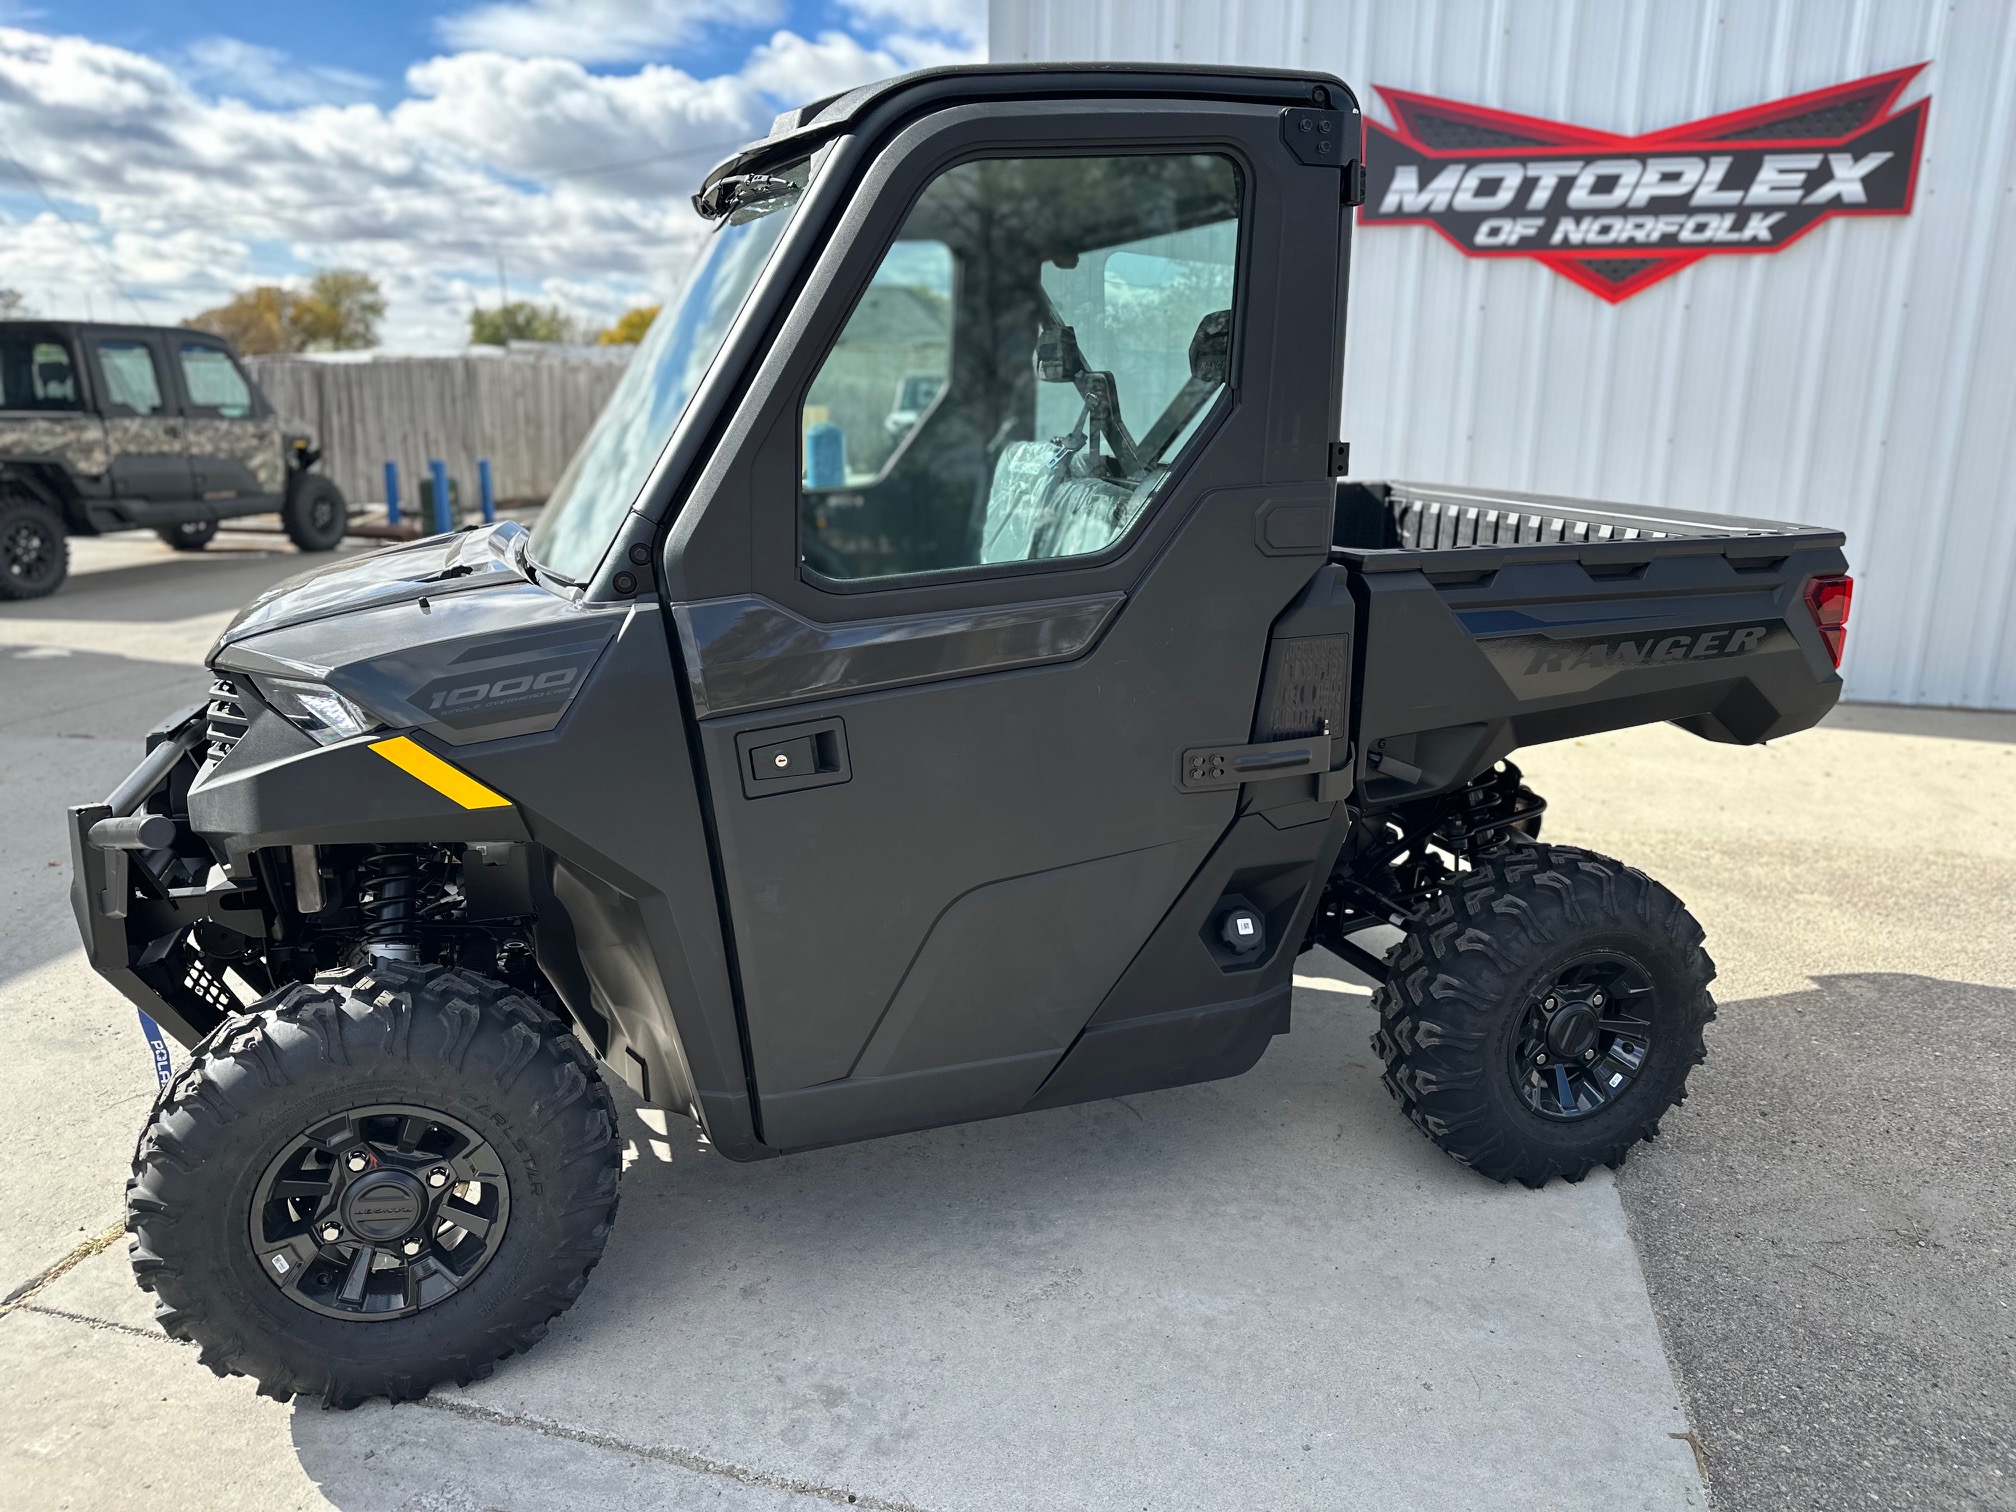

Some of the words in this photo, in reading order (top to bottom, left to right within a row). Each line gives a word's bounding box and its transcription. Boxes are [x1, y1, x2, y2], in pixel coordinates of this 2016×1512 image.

[1378, 151, 1896, 214] MOTOPLEX
[1472, 216, 1546, 247] OF
[1550, 211, 1787, 245] NORFOLK
[1200, 360, 1228, 369] RANGE
[1522, 626, 1768, 677] RANGER
[428, 666, 578, 710] 1000
[440, 703, 482, 716] SINGLE
[485, 692, 544, 708] OVERHEAD
[545, 687, 571, 697] CAM
